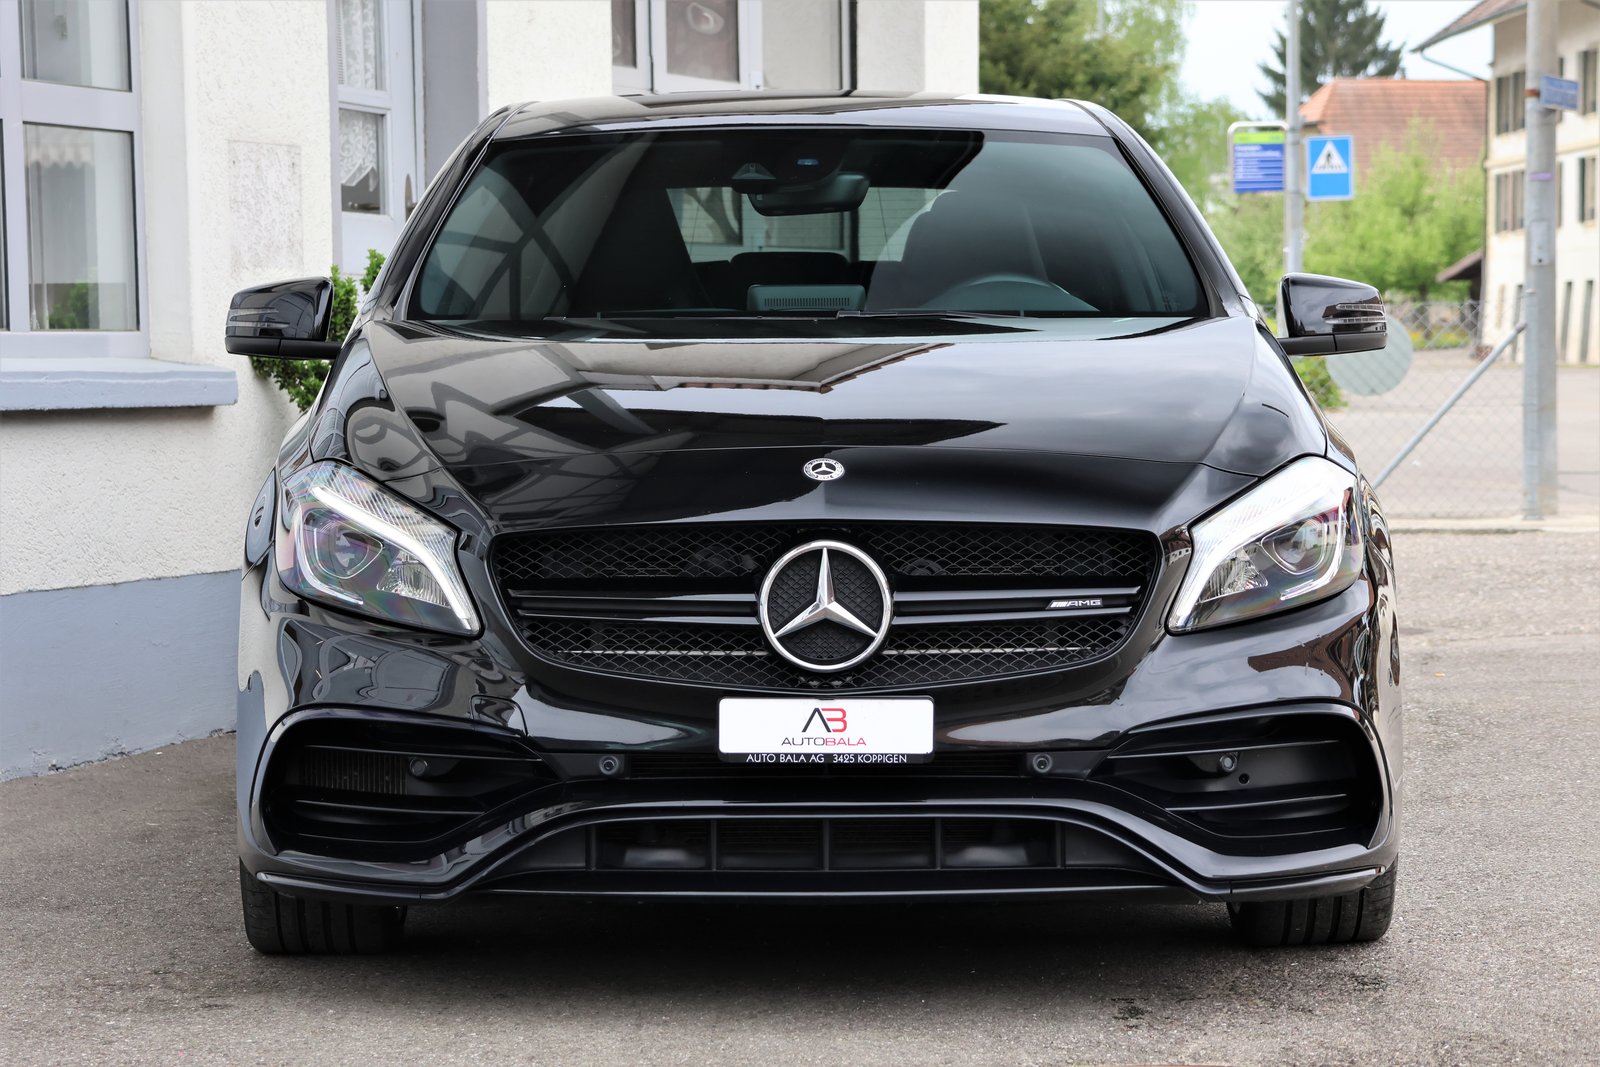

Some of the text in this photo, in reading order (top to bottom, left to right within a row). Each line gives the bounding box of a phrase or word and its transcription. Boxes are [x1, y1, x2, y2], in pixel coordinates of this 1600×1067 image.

[1066, 599, 1101, 607] AMG
[781, 737, 867, 747] AUTOBALA
[746, 754, 907, 764] AUTO BALA AG 3425 KOPPIGEN
